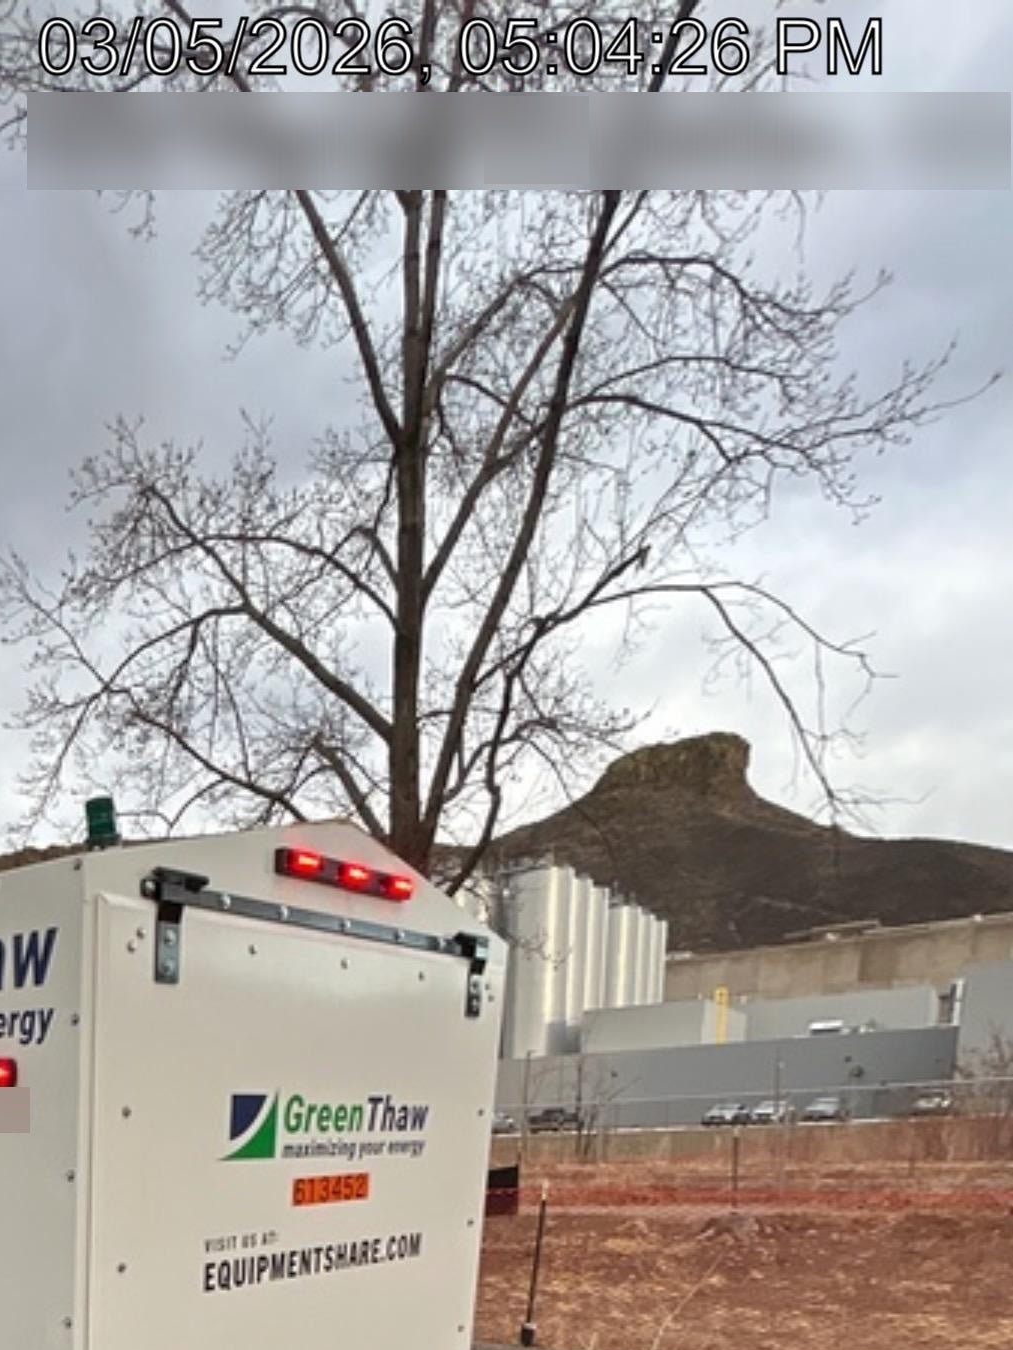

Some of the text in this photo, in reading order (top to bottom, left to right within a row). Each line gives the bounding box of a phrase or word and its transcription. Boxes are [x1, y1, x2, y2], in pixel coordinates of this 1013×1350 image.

[282, 1138, 426, 1161] maximizing your energy
[293, 1173, 367, 1205] 613452
[204, 1235, 237, 1253] VISIT
[242, 1232, 257, 1249] US
[204, 1231, 423, 1292] EQUIPMENTSHARE.COM
